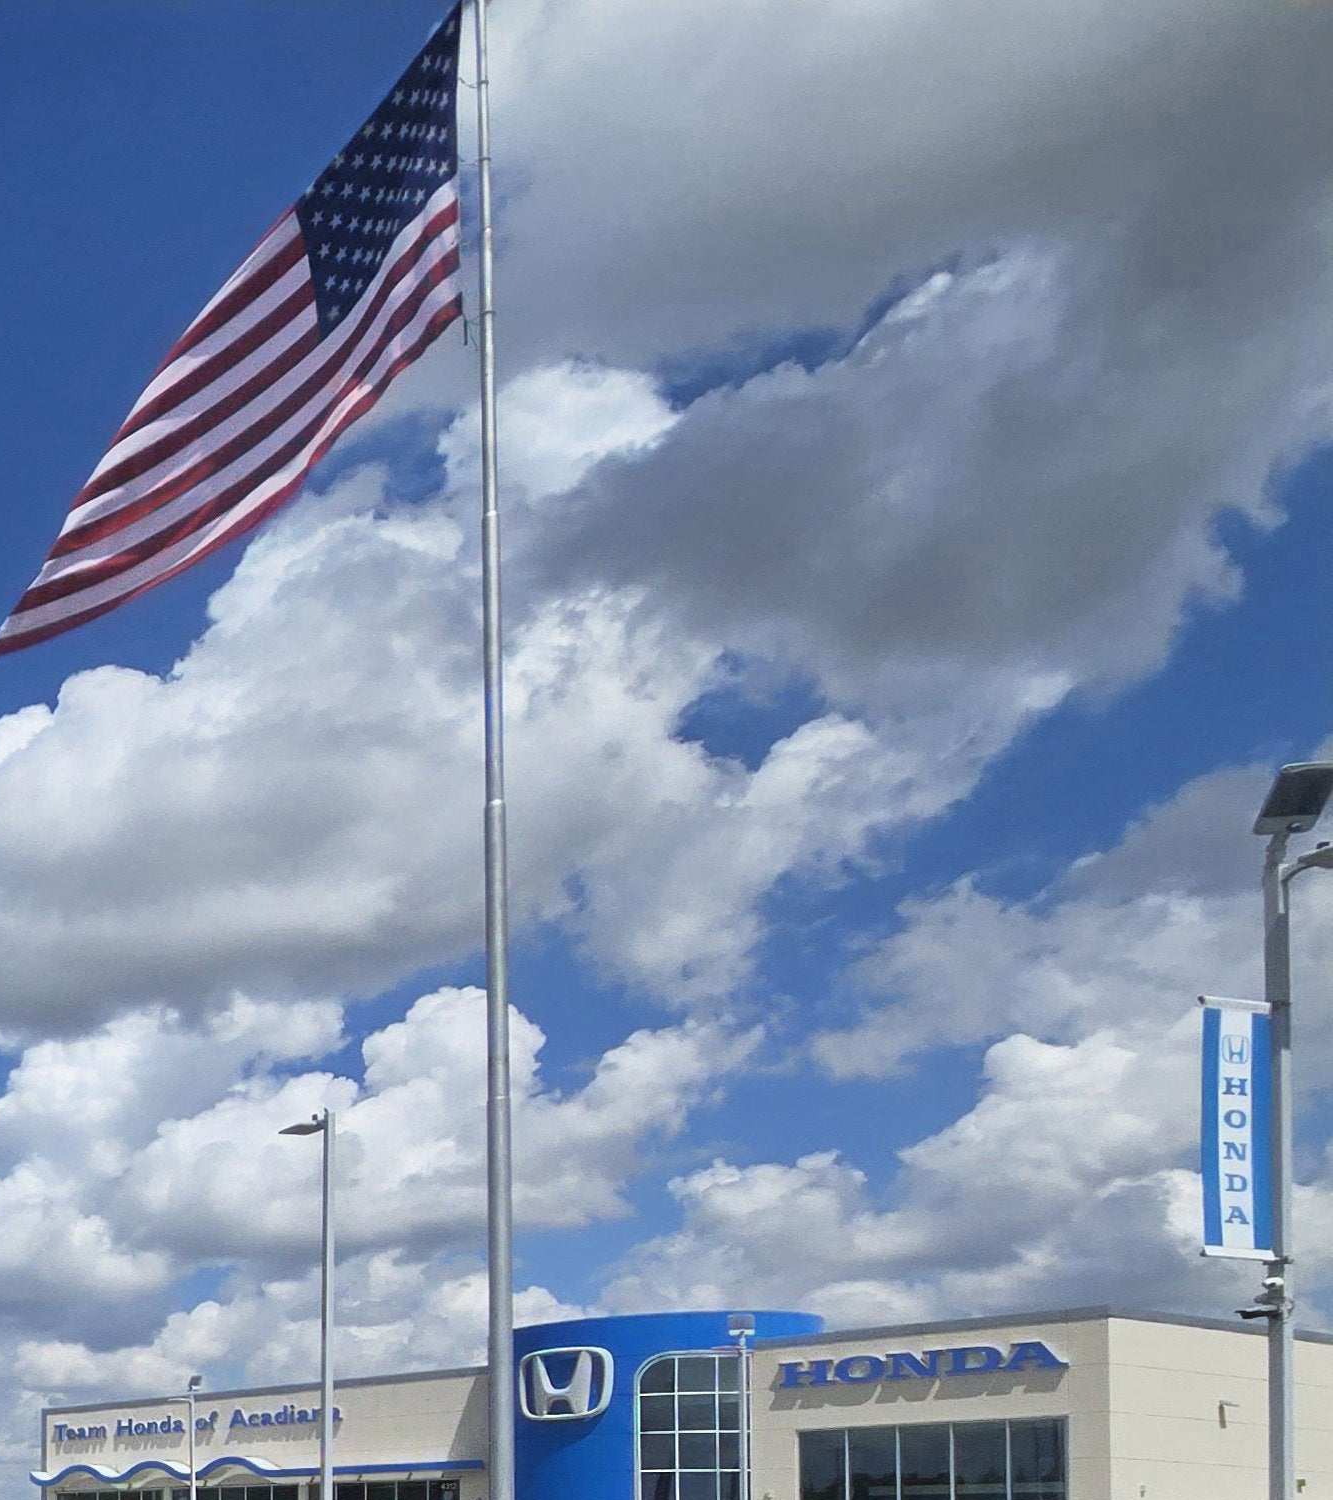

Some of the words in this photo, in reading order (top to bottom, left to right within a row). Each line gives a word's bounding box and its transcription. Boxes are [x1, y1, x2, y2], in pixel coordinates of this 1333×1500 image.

[1221, 1076, 1250, 1225] HONDA
[778, 1341, 1070, 1389] HONDA
[53, 1423, 107, 1442] Team
[116, 1415, 186, 1437] Honda
[194, 1410, 219, 1432] of
